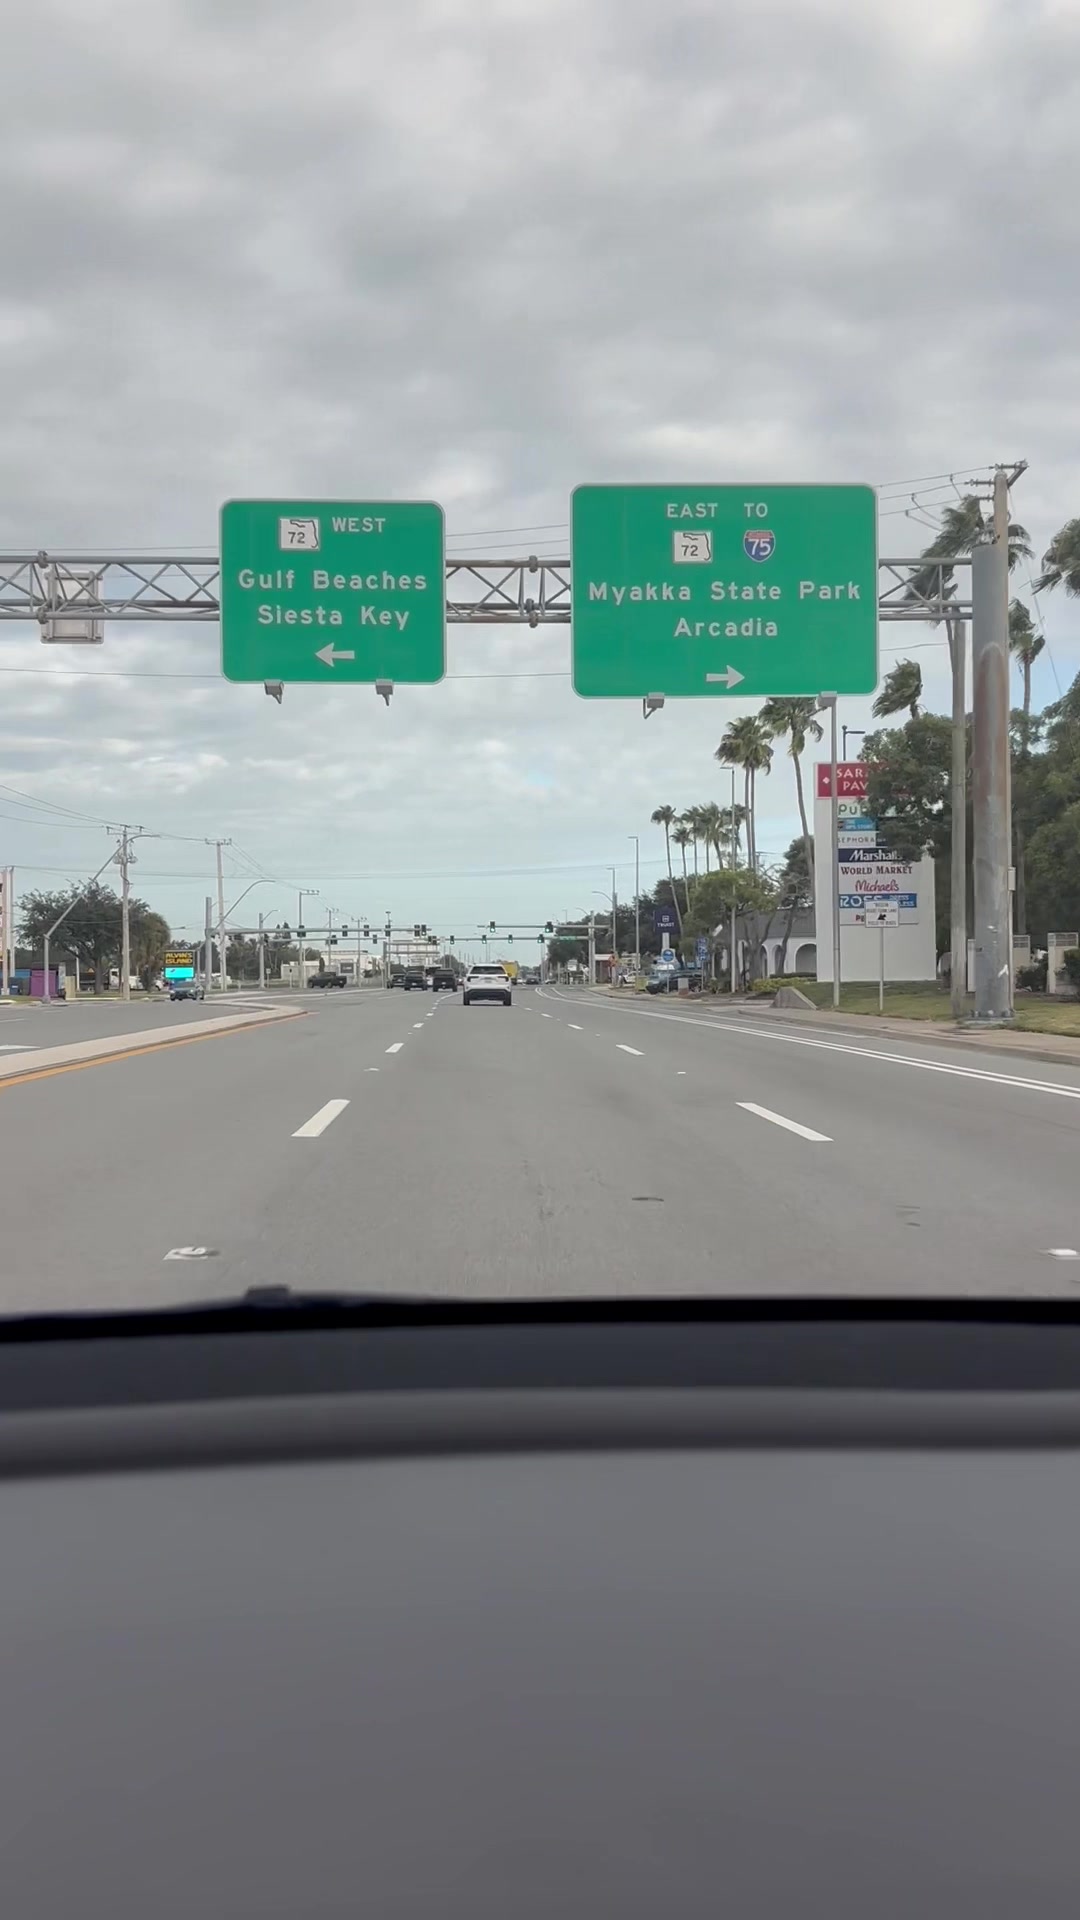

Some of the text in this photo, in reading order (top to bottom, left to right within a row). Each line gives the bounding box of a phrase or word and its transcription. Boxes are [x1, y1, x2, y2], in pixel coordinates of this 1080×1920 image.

[667, 503, 768, 518] EAST TO
[332, 517, 386, 533] WEST
[288, 531, 306, 544] 72
[681, 545, 699, 557] 72
[748, 538, 771, 556] 75
[238, 568, 428, 590] Gulf Beaches
[589, 581, 861, 606] Myakka State Park
[257, 604, 410, 631] Siesta Key
[674, 618, 778, 637] Arcadia
[841, 865, 913, 875] WORLD MARKET
